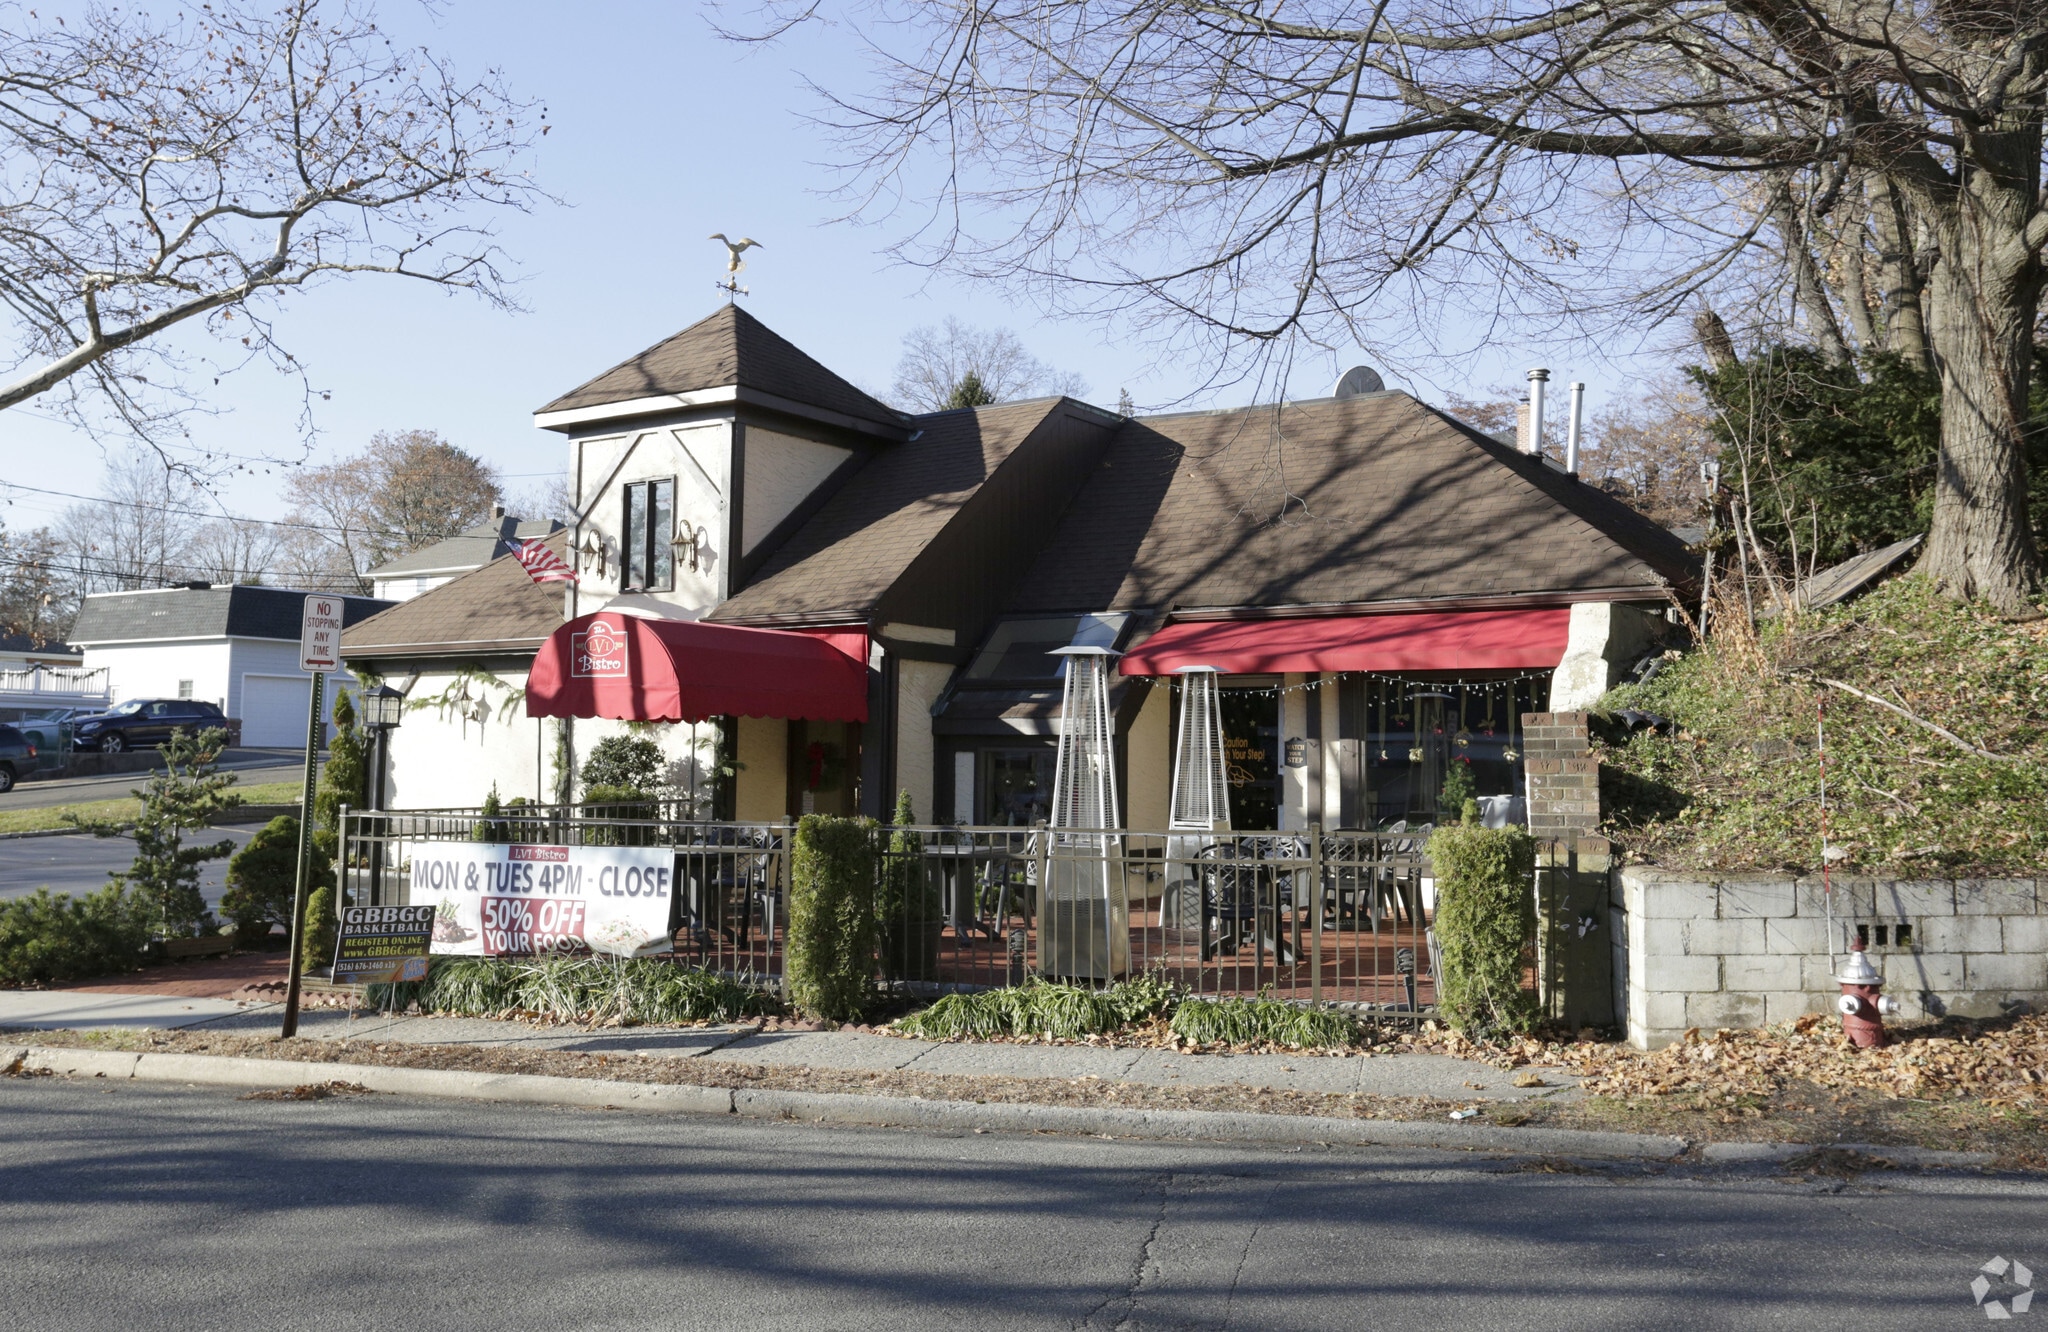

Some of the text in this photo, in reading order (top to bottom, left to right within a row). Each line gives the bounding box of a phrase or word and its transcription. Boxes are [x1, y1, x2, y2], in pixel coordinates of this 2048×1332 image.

[317, 603, 331, 616] NO
[307, 617, 339, 629] STOPPING
[314, 632, 330, 642] ANY
[313, 645, 329, 656] TIME
[578, 655, 621, 673] Bistro
[1223, 736, 1248, 748] Caution
[534, 848, 566, 860] Bistro
[413, 860, 460, 891] MON
[464, 861, 480, 892] &
[485, 862, 534, 894] TUES
[539, 864, 583, 895] 4PM
[599, 865, 669, 898] CLOSE
[347, 907, 431, 924] GBBGC
[484, 899, 585, 934] 50% OFF
[345, 923, 429, 934] BASKETBALL
[345, 936, 425, 947] REGISTER ONLINE:
[485, 930, 586, 953] YOUR FOOD
[343, 946, 422, 958] www.GBBGC.org
